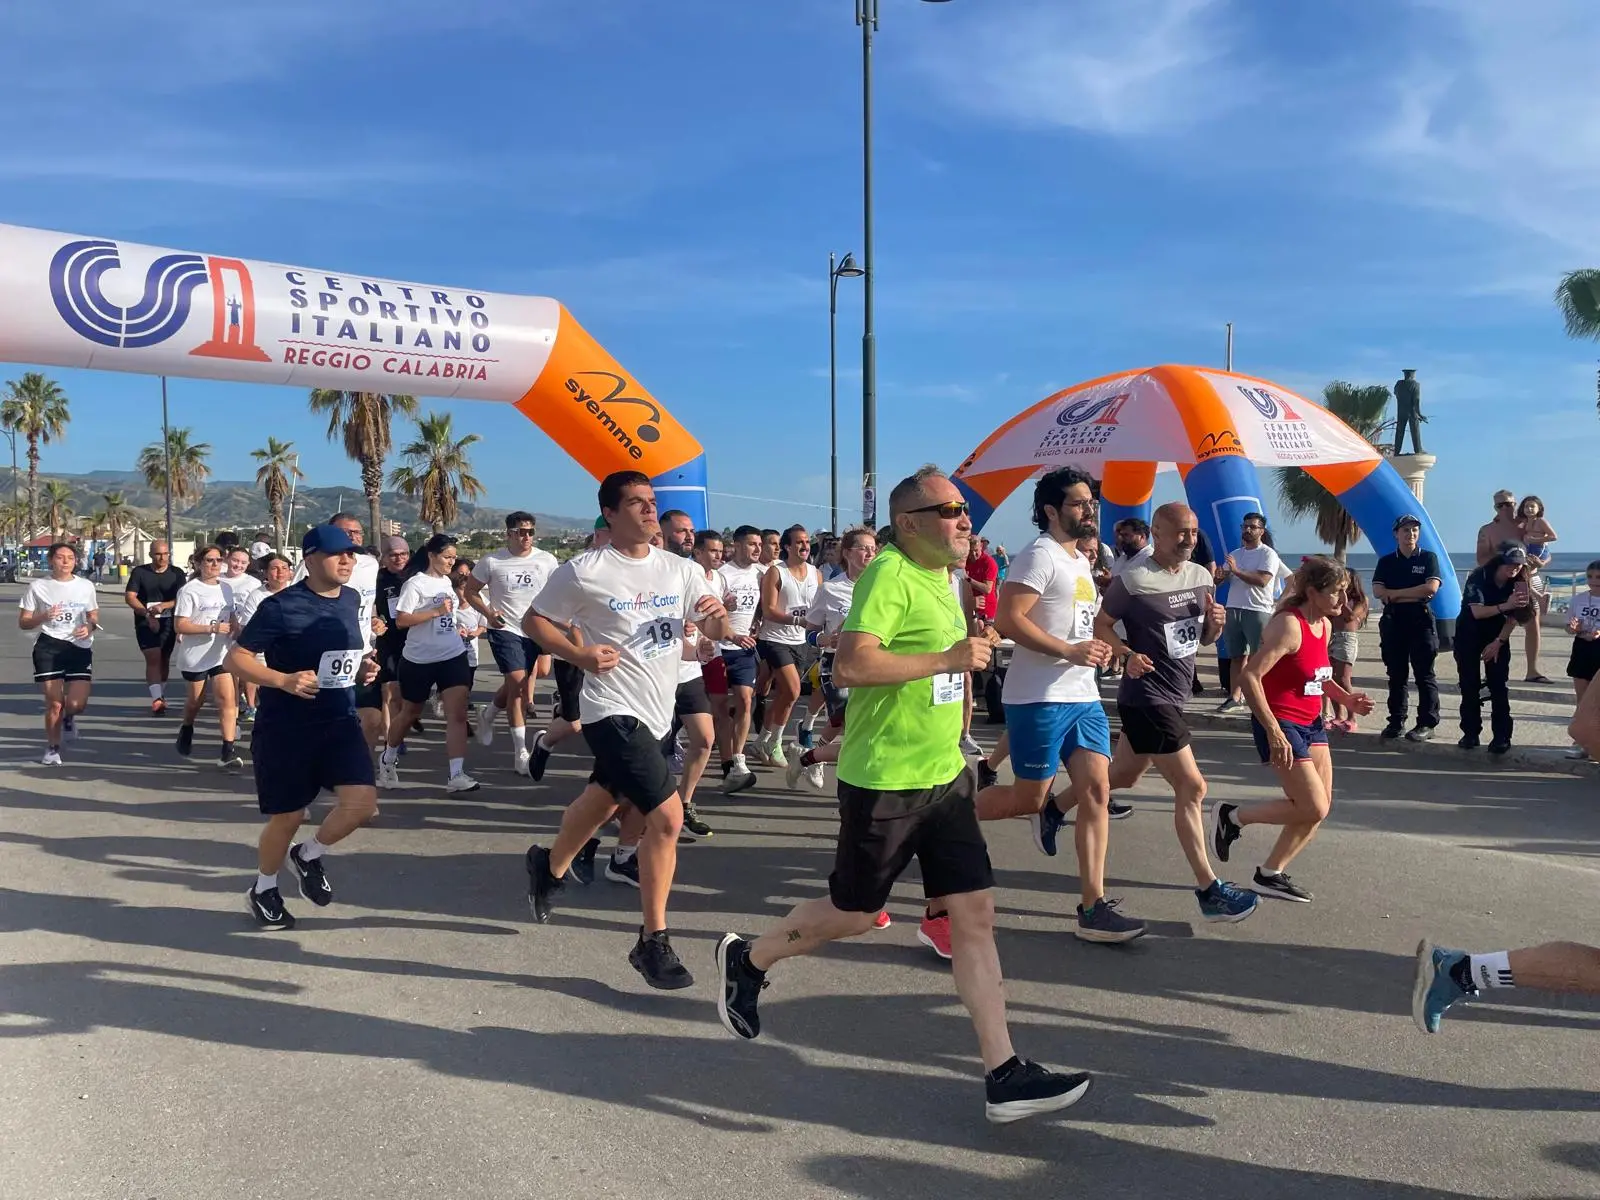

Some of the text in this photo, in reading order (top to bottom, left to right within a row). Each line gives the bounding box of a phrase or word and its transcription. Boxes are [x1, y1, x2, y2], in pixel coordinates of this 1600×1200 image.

[285, 271, 485, 309] CENTRO
[289, 288, 489, 329] SPORTIVO
[291, 312, 491, 353] ITALIANO
[284, 347, 488, 381] REGGIO CALABRIA
[564, 378, 643, 460] syemme
[1047, 425, 1116, 435] CENTRO
[1263, 422, 1307, 432] CENTRO
[1043, 431, 1111, 442] SPORTIVO
[1266, 431, 1309, 441] SPORTIVO
[1039, 437, 1107, 449] ITALIANO
[1270, 440, 1313, 449] ITALIANO
[1063, 446, 1102, 456] CALABRIA
[515, 574, 532, 584] 76
[741, 595, 754, 606] 23
[1581, 606, 1600, 617] 50
[440, 617, 454, 628] 52
[646, 622, 673, 644] 18
[1177, 626, 1197, 644] 38
[331, 658, 353, 676] 96
